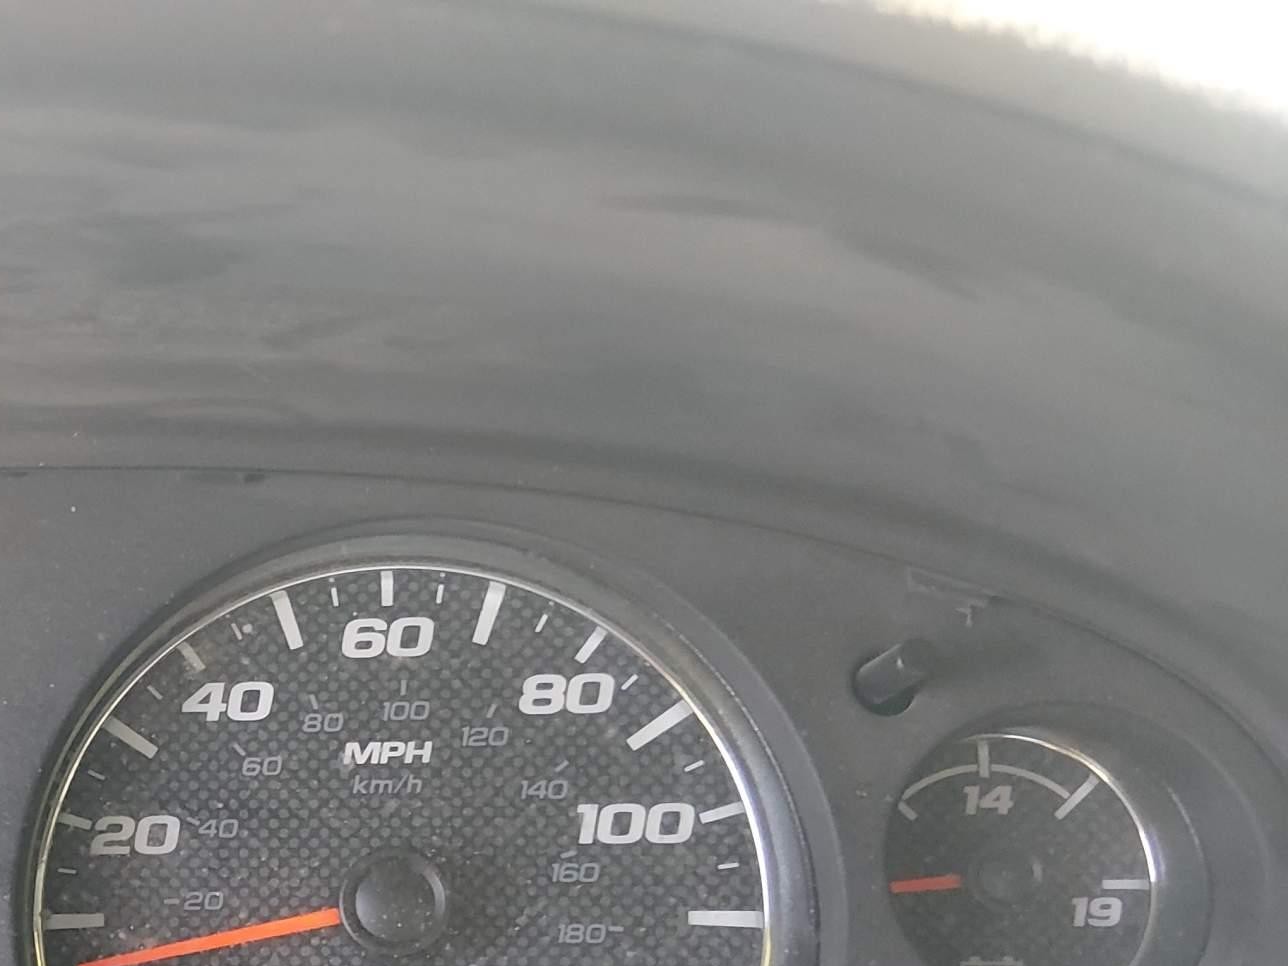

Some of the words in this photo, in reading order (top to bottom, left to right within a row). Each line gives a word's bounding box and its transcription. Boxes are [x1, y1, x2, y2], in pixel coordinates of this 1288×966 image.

[342, 617, 434, 658] 60
[181, 681, 275, 722] 40
[518, 673, 614, 715] 80
[381, 701, 430, 721] 100
[302, 713, 344, 733] 80
[462, 726, 509, 747] 120
[343, 741, 433, 765] MPH
[242, 756, 283, 776] 60
[352, 774, 423, 795] km/h
[520, 780, 569, 800] 140
[963, 785, 1015, 815] 14
[198, 818, 239, 838] 40
[576, 802, 696, 845] 100
[89, 815, 181, 856] 20
[551, 862, 601, 883] 160
[183, 891, 224, 911] 20
[1071, 896, 1123, 928] 19
[558, 923, 607, 944] 180
